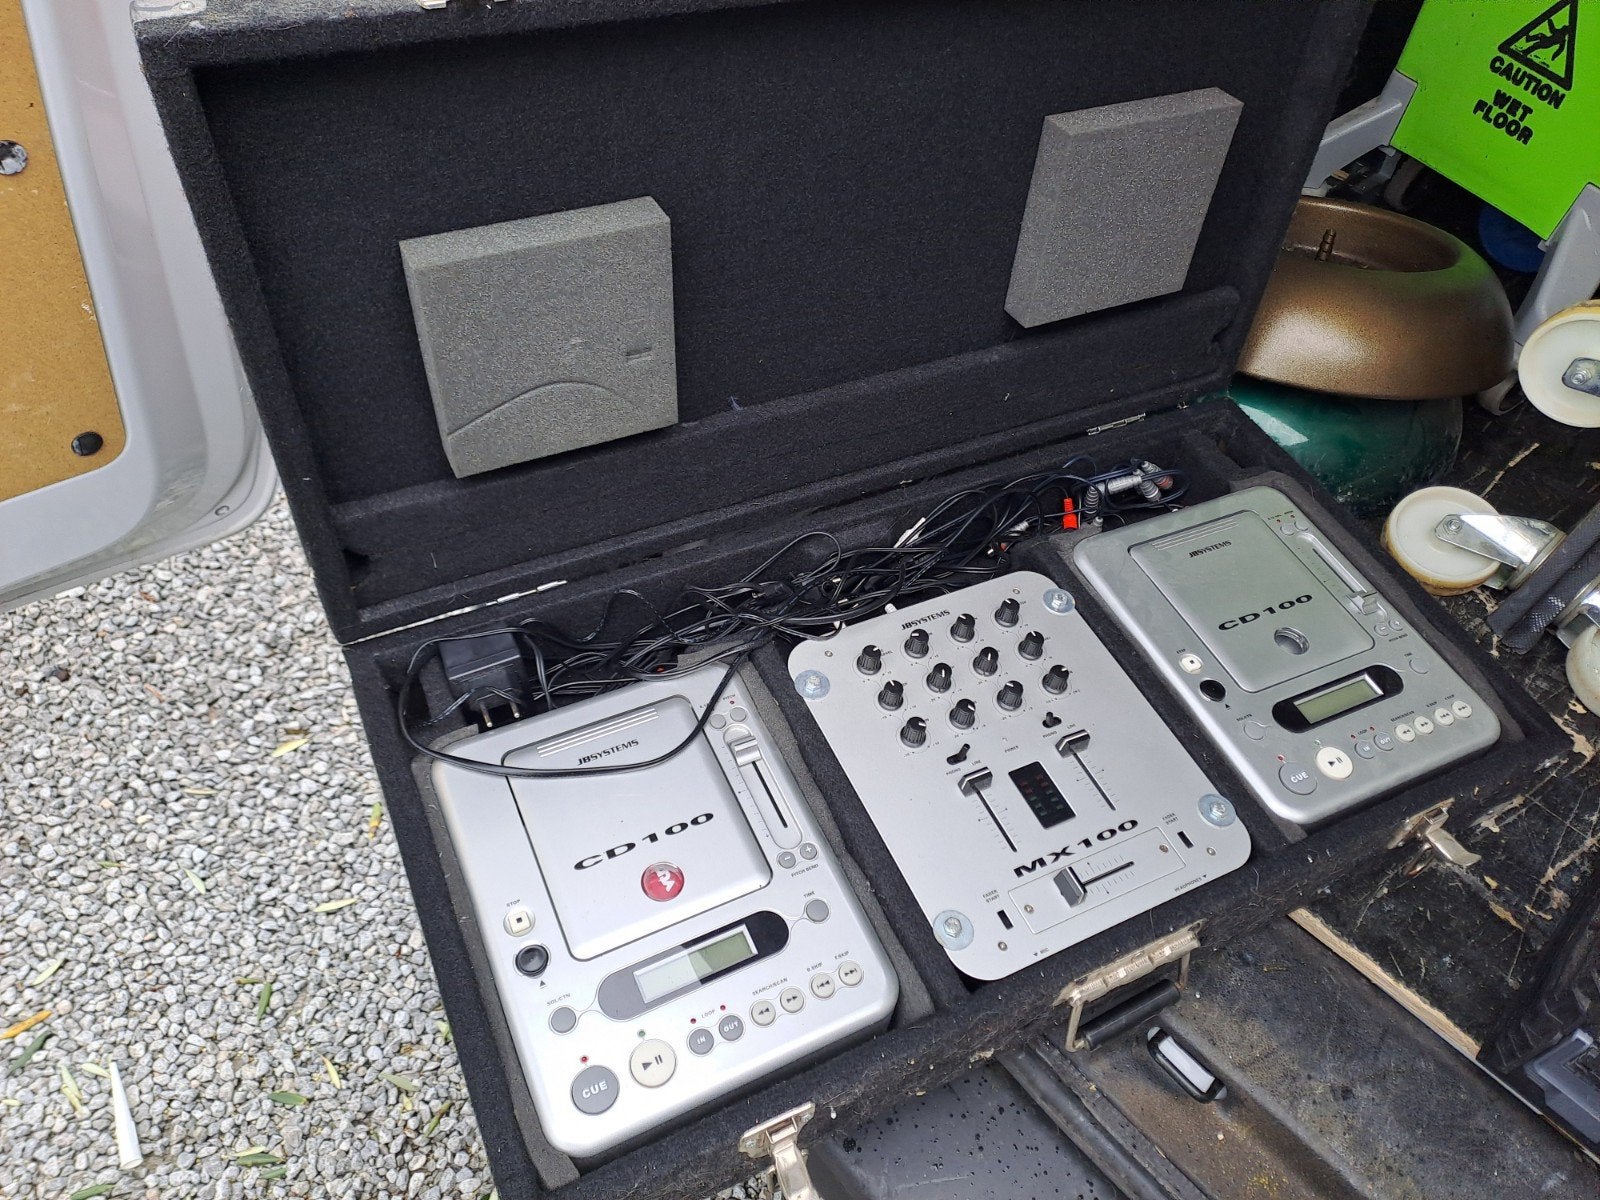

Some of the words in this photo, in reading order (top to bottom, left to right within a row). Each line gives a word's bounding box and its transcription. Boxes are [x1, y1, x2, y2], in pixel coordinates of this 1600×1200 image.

[1489, 55, 1566, 109] CAUTION
[1492, 89, 1533, 122] WET
[1472, 99, 1534, 145] FLOOR
[1189, 540, 1232, 558] JBSYSTEMS
[901, 610, 950, 630] JBSYSTEMS
[1218, 594, 1313, 631] CD100
[577, 738, 639, 766] JBSYSTEMS
[1290, 771, 1309, 783] CUE
[574, 812, 714, 870] CD100
[1013, 819, 1139, 878] MX100
[506, 899, 520, 907] STOP
[701, 1009, 716, 1019] LOOP
[723, 1020, 739, 1032] OUT
[697, 1035, 706, 1045] IN
[582, 1080, 608, 1099] CUE
